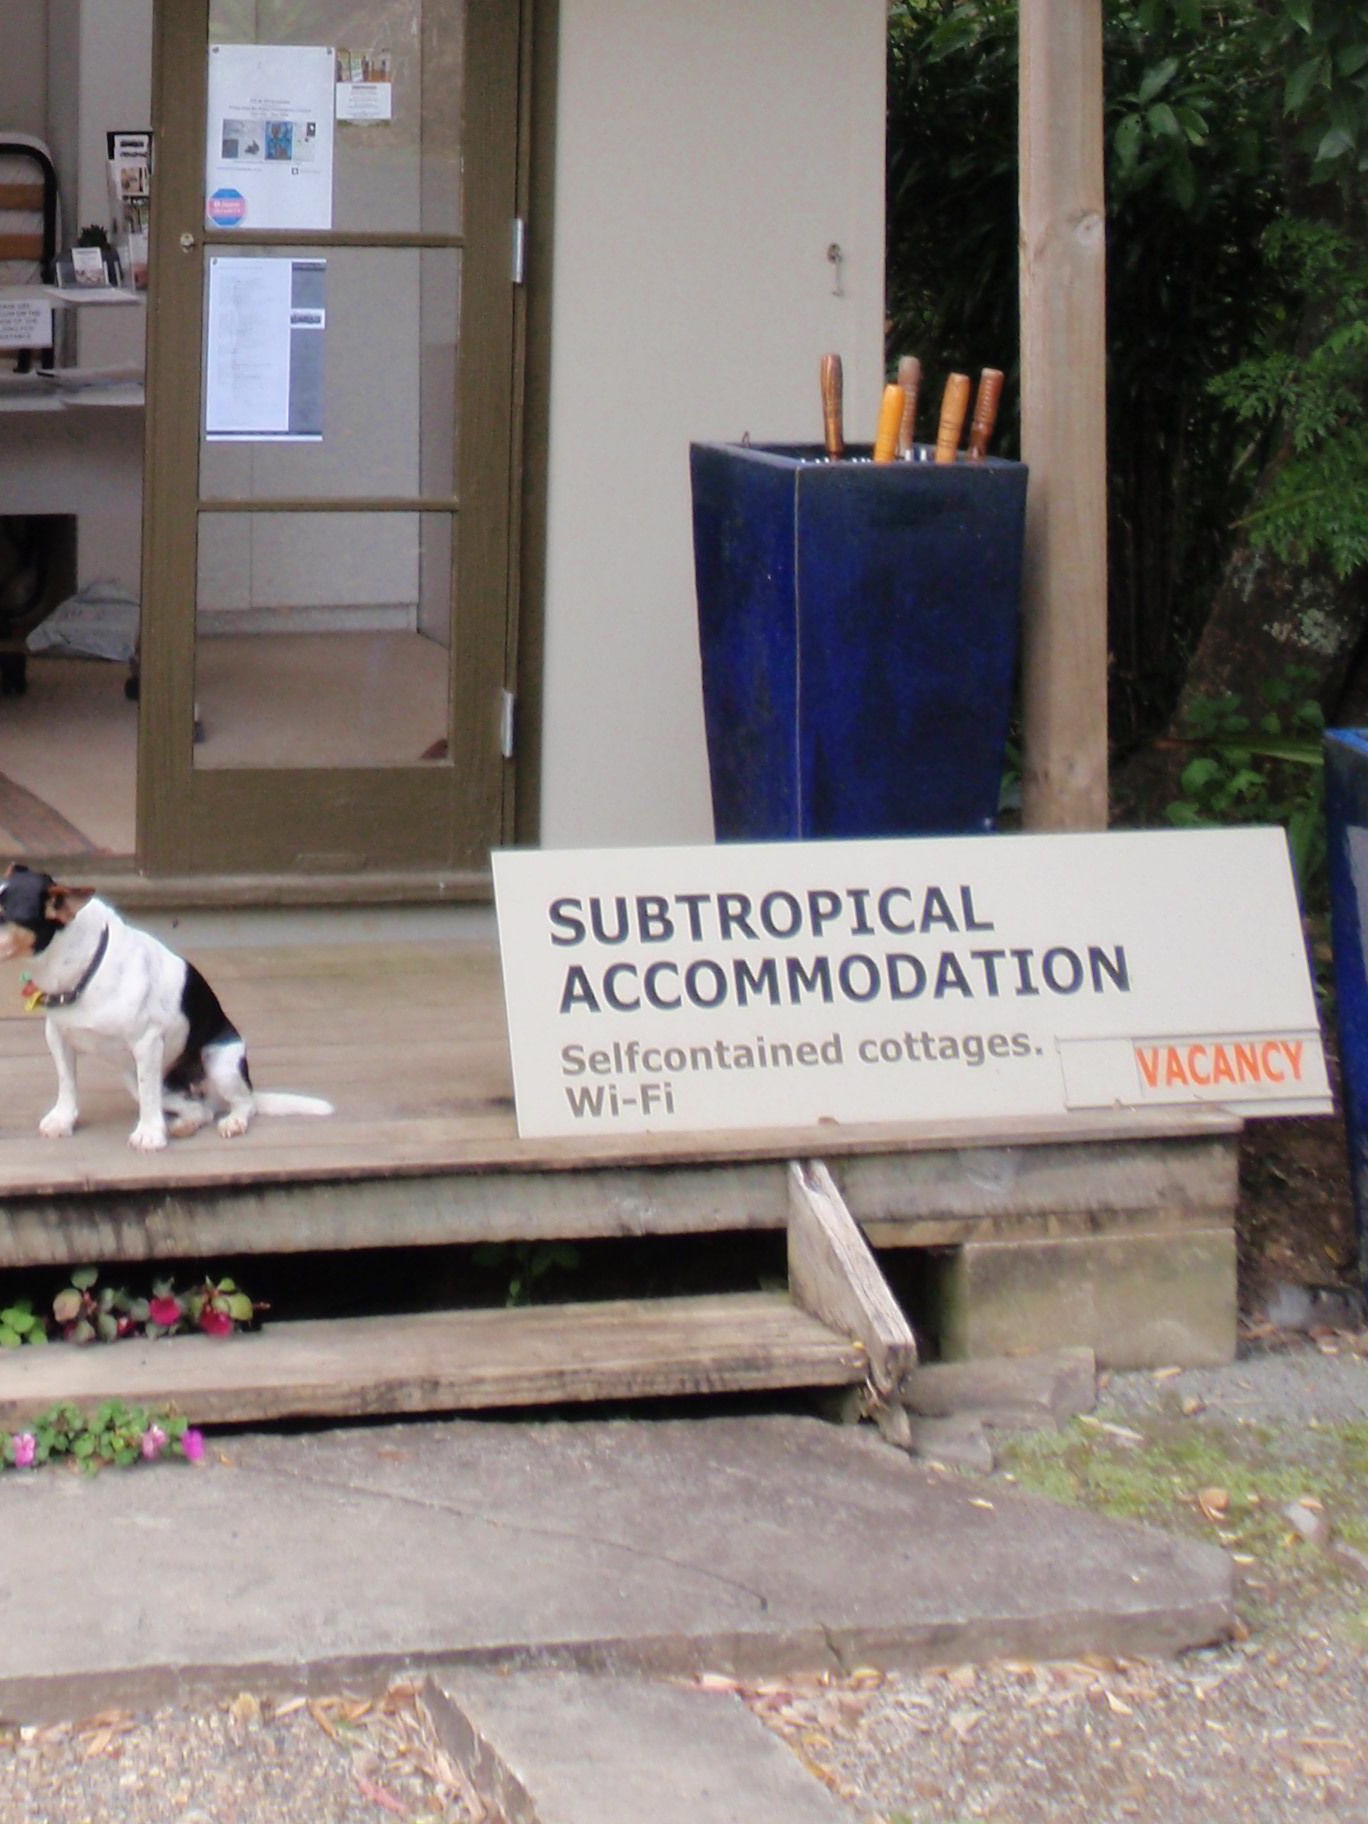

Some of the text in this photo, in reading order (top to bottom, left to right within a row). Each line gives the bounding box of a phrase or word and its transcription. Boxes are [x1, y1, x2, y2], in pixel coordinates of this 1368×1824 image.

[549, 885, 995, 947] SUBTROPICAL
[559, 945, 1132, 1015] ACCOMMODATION
[561, 1031, 1045, 1076] Selfcontained cottages.
[1135, 1040, 1307, 1089] VACANCY
[564, 1082, 676, 1119] Wi-Fi
